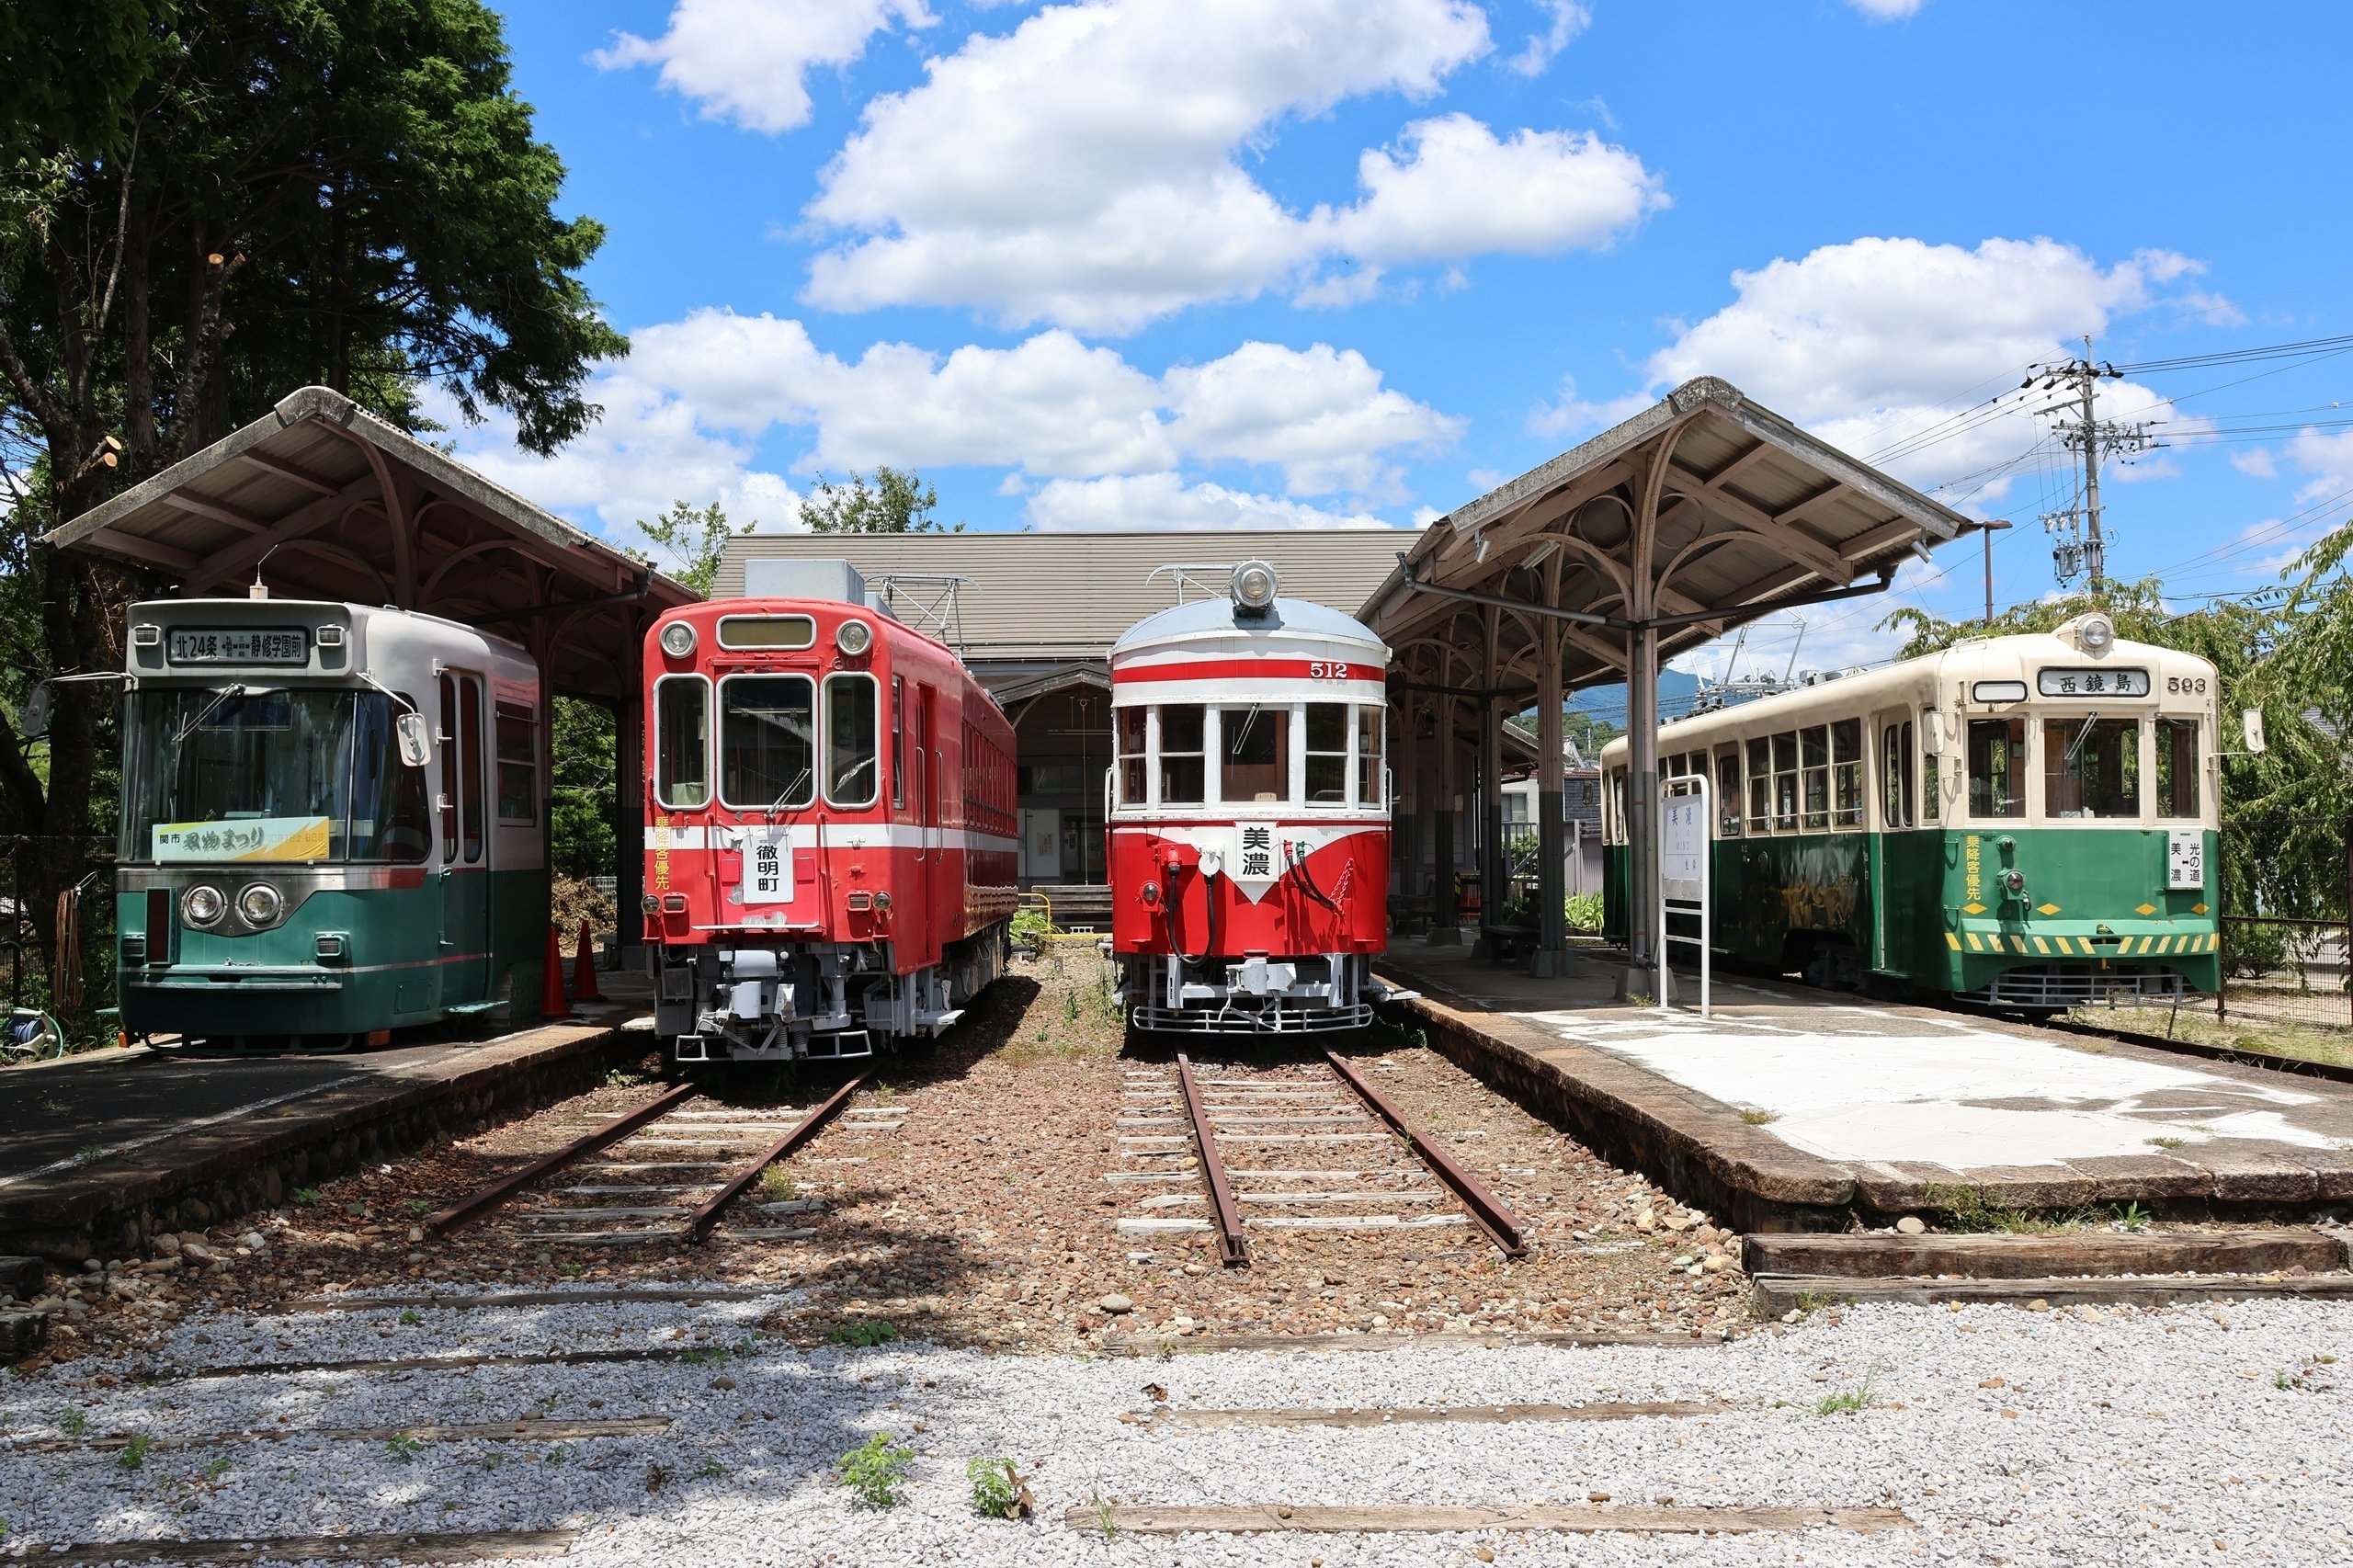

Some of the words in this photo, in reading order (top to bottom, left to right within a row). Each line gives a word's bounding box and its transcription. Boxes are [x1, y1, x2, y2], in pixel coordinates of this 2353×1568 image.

[1310, 662, 1347, 678] 512
[2060, 673, 2131, 693] 西鏡島
[2167, 676, 2206, 692] 593
[159, 835, 181, 845] 関市
[1243, 826, 1269, 876] 美濃
[756, 845, 779, 892] 徹明町
[1966, 835, 1981, 901] 乗降客優先
[2170, 842, 2181, 881] 美濃
[2189, 843, 2200, 881] 光の道
